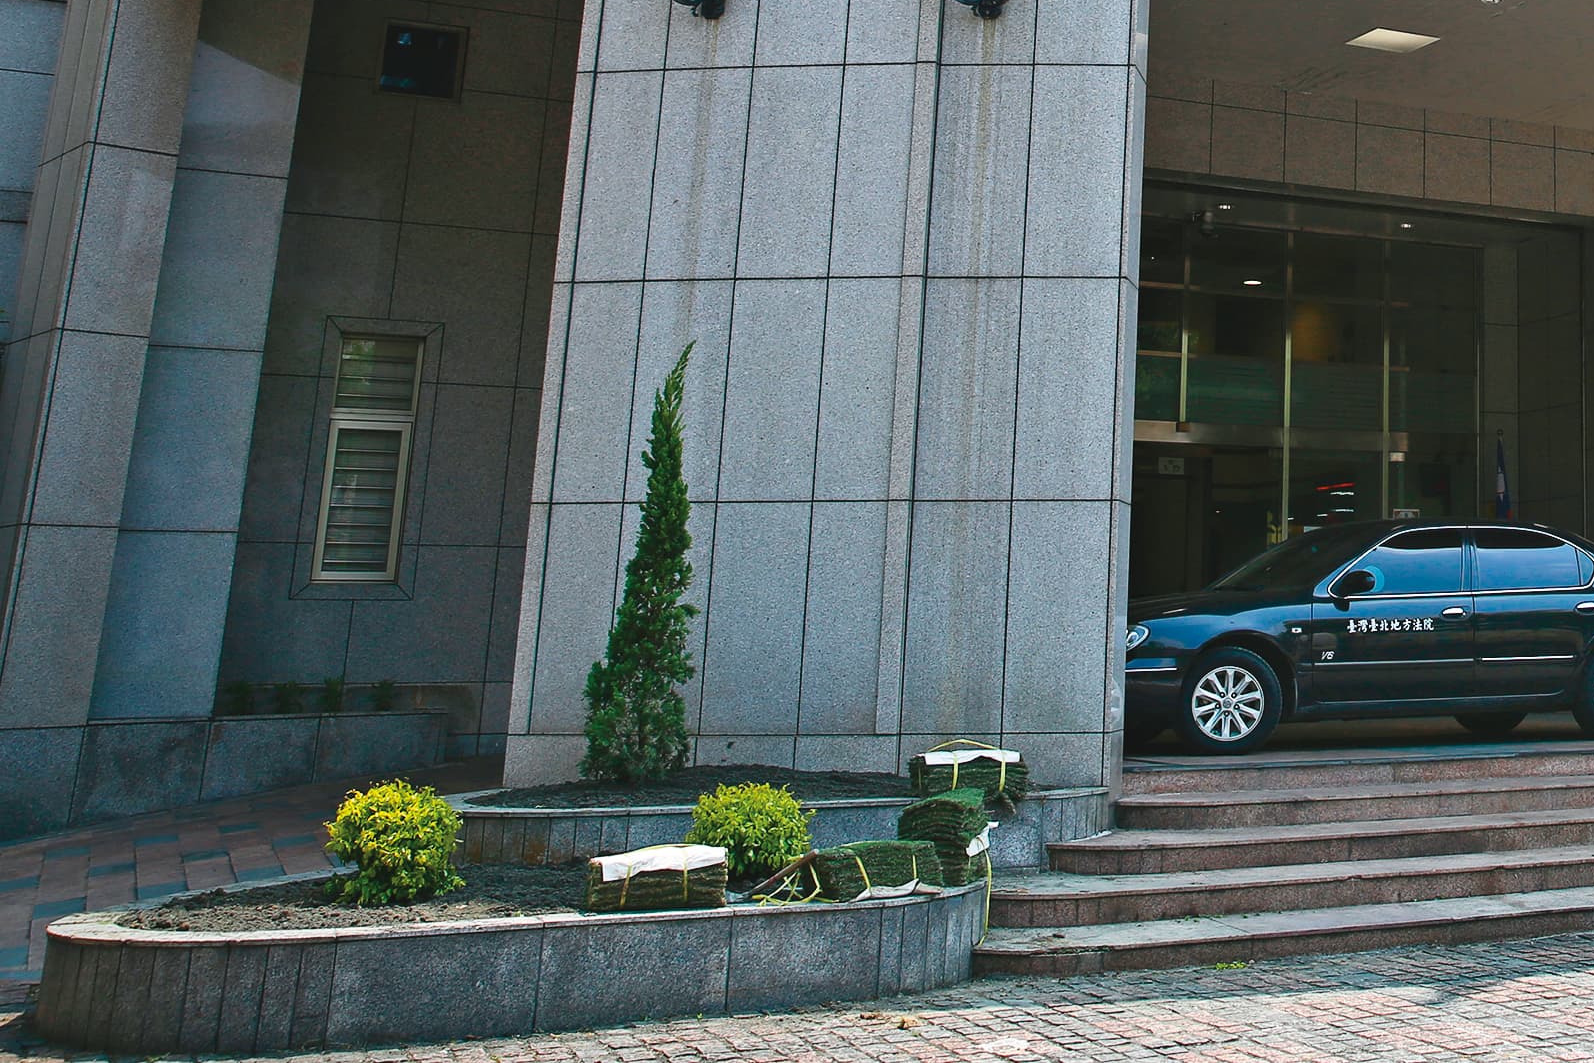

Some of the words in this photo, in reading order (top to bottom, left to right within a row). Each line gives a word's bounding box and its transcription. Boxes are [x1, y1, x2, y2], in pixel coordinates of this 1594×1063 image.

[1347, 618, 1435, 633] 臺灣臺北地方法院
[1321, 650, 1335, 660] V6
